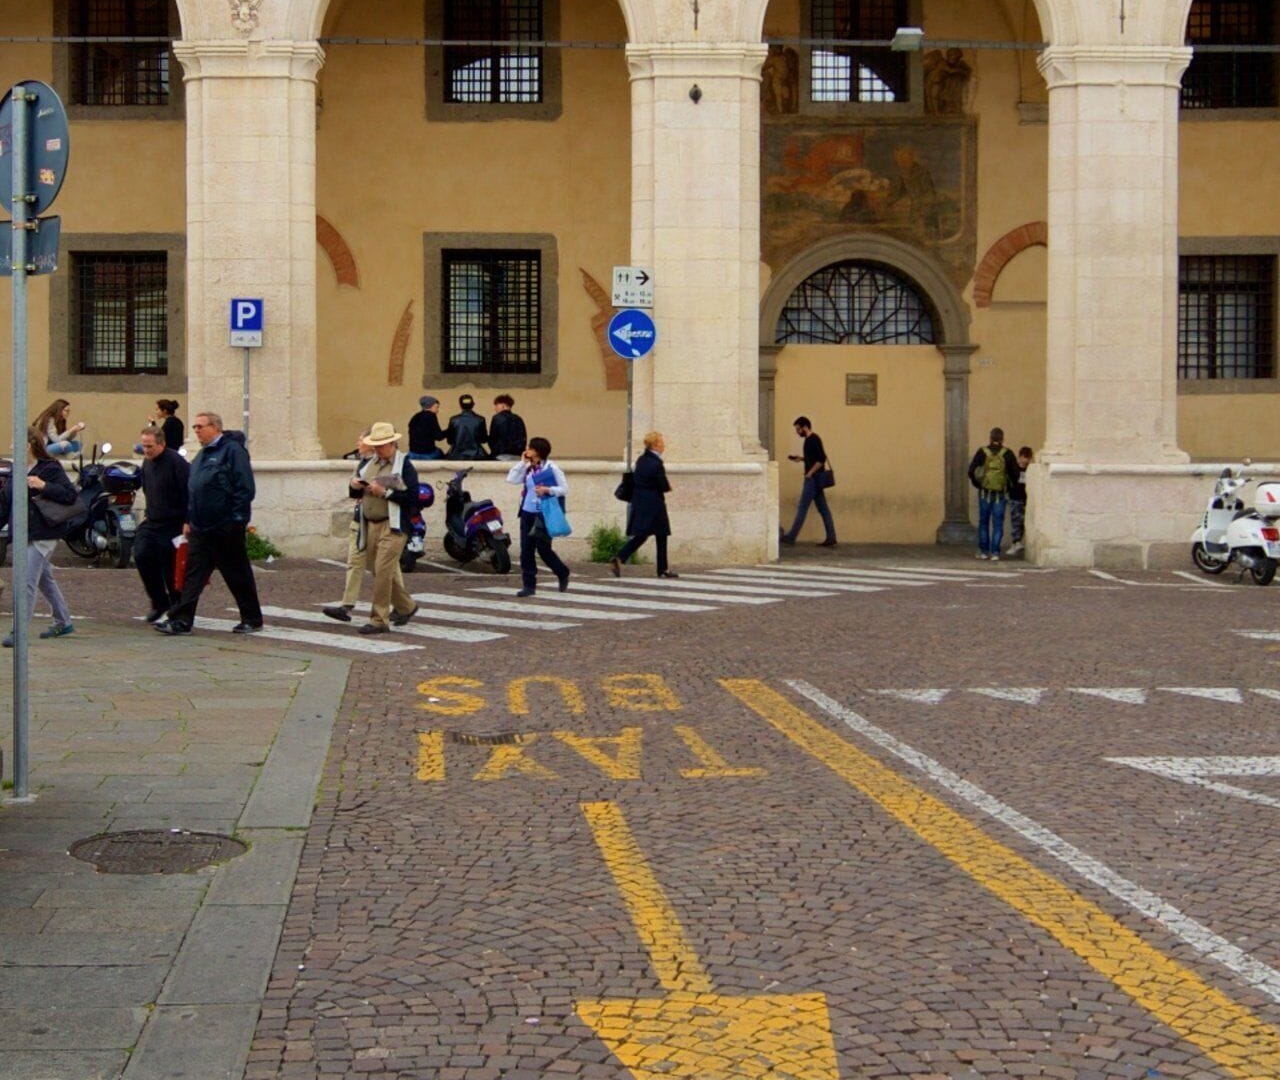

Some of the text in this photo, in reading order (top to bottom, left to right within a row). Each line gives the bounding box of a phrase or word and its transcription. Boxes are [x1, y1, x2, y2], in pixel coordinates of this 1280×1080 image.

[237, 302, 256, 328] P
[416, 672, 684, 716] BUS
[416, 726, 769, 781] TAXI
